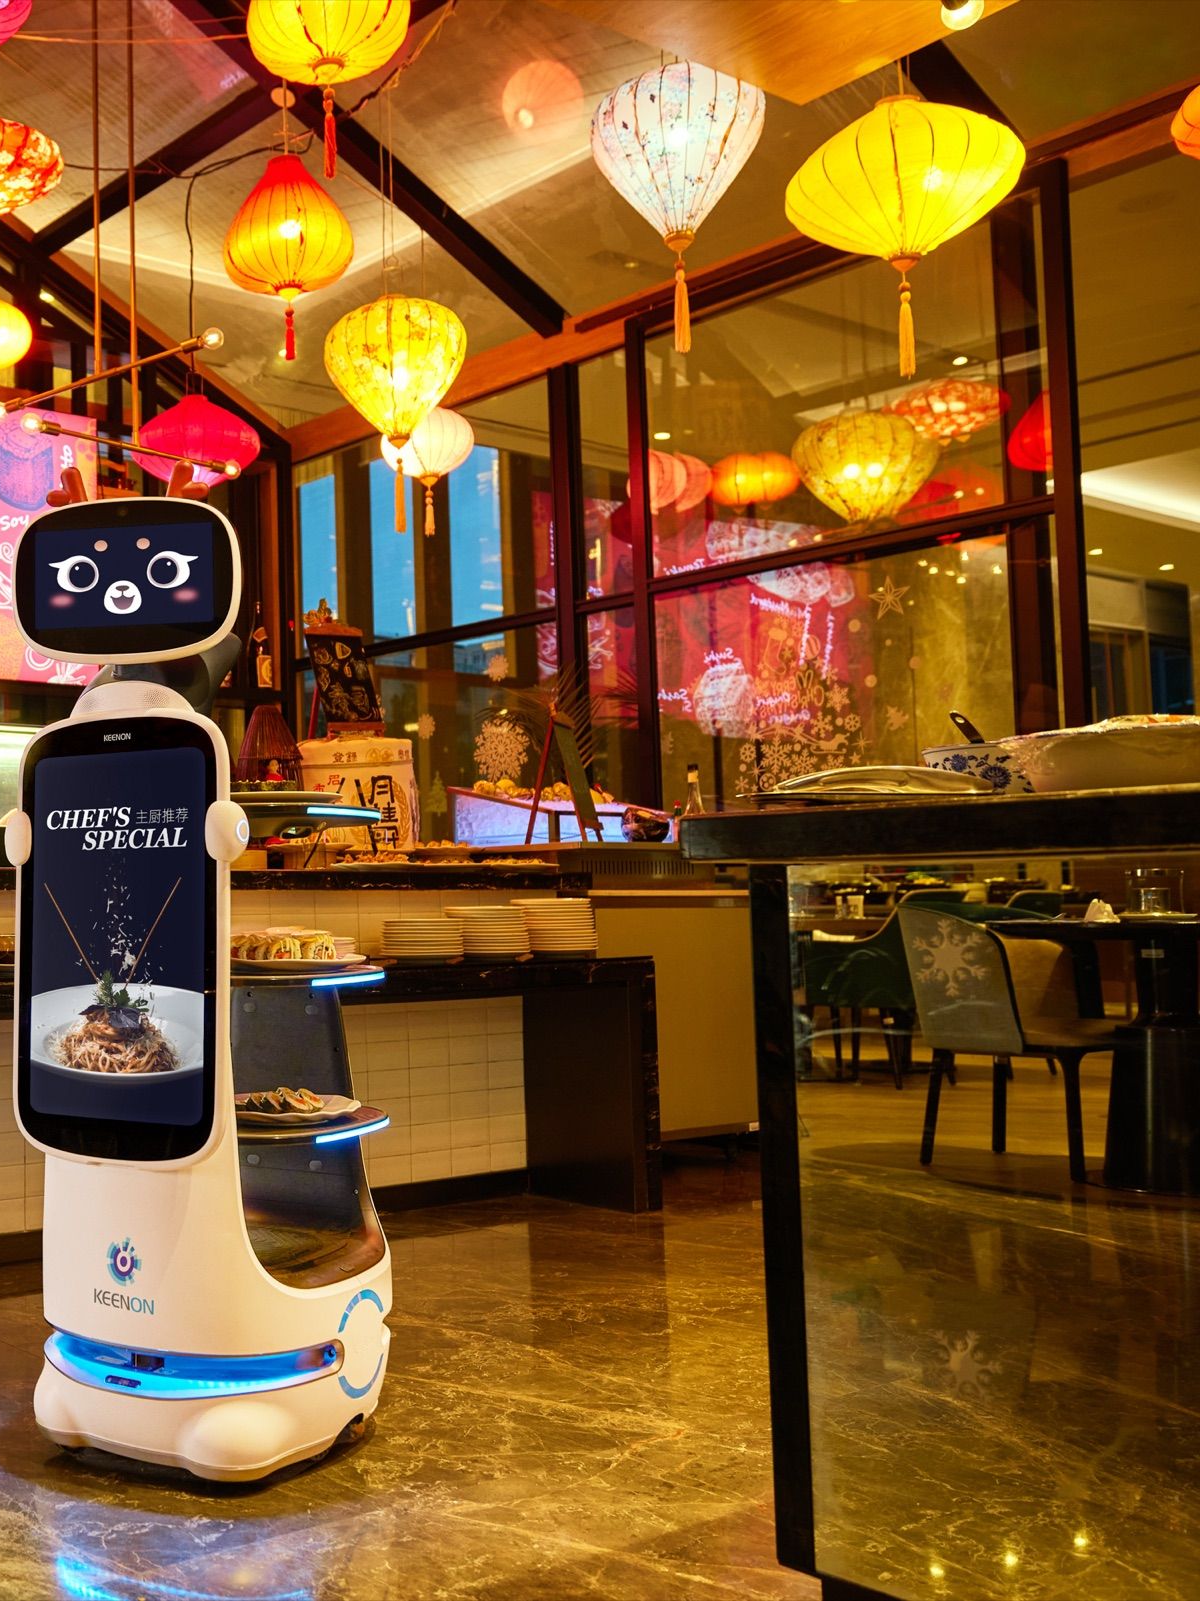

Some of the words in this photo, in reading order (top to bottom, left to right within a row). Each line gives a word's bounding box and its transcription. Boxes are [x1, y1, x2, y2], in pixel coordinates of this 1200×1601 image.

[0, 514, 29, 531] Soy
[103, 733, 131, 742] KEENON
[46, 806, 131, 830] CHEF'S
[136, 807, 189, 824] 主厨推荐
[82, 827, 188, 851] SPECIAL
[93, 1288, 154, 1315] KEENON
